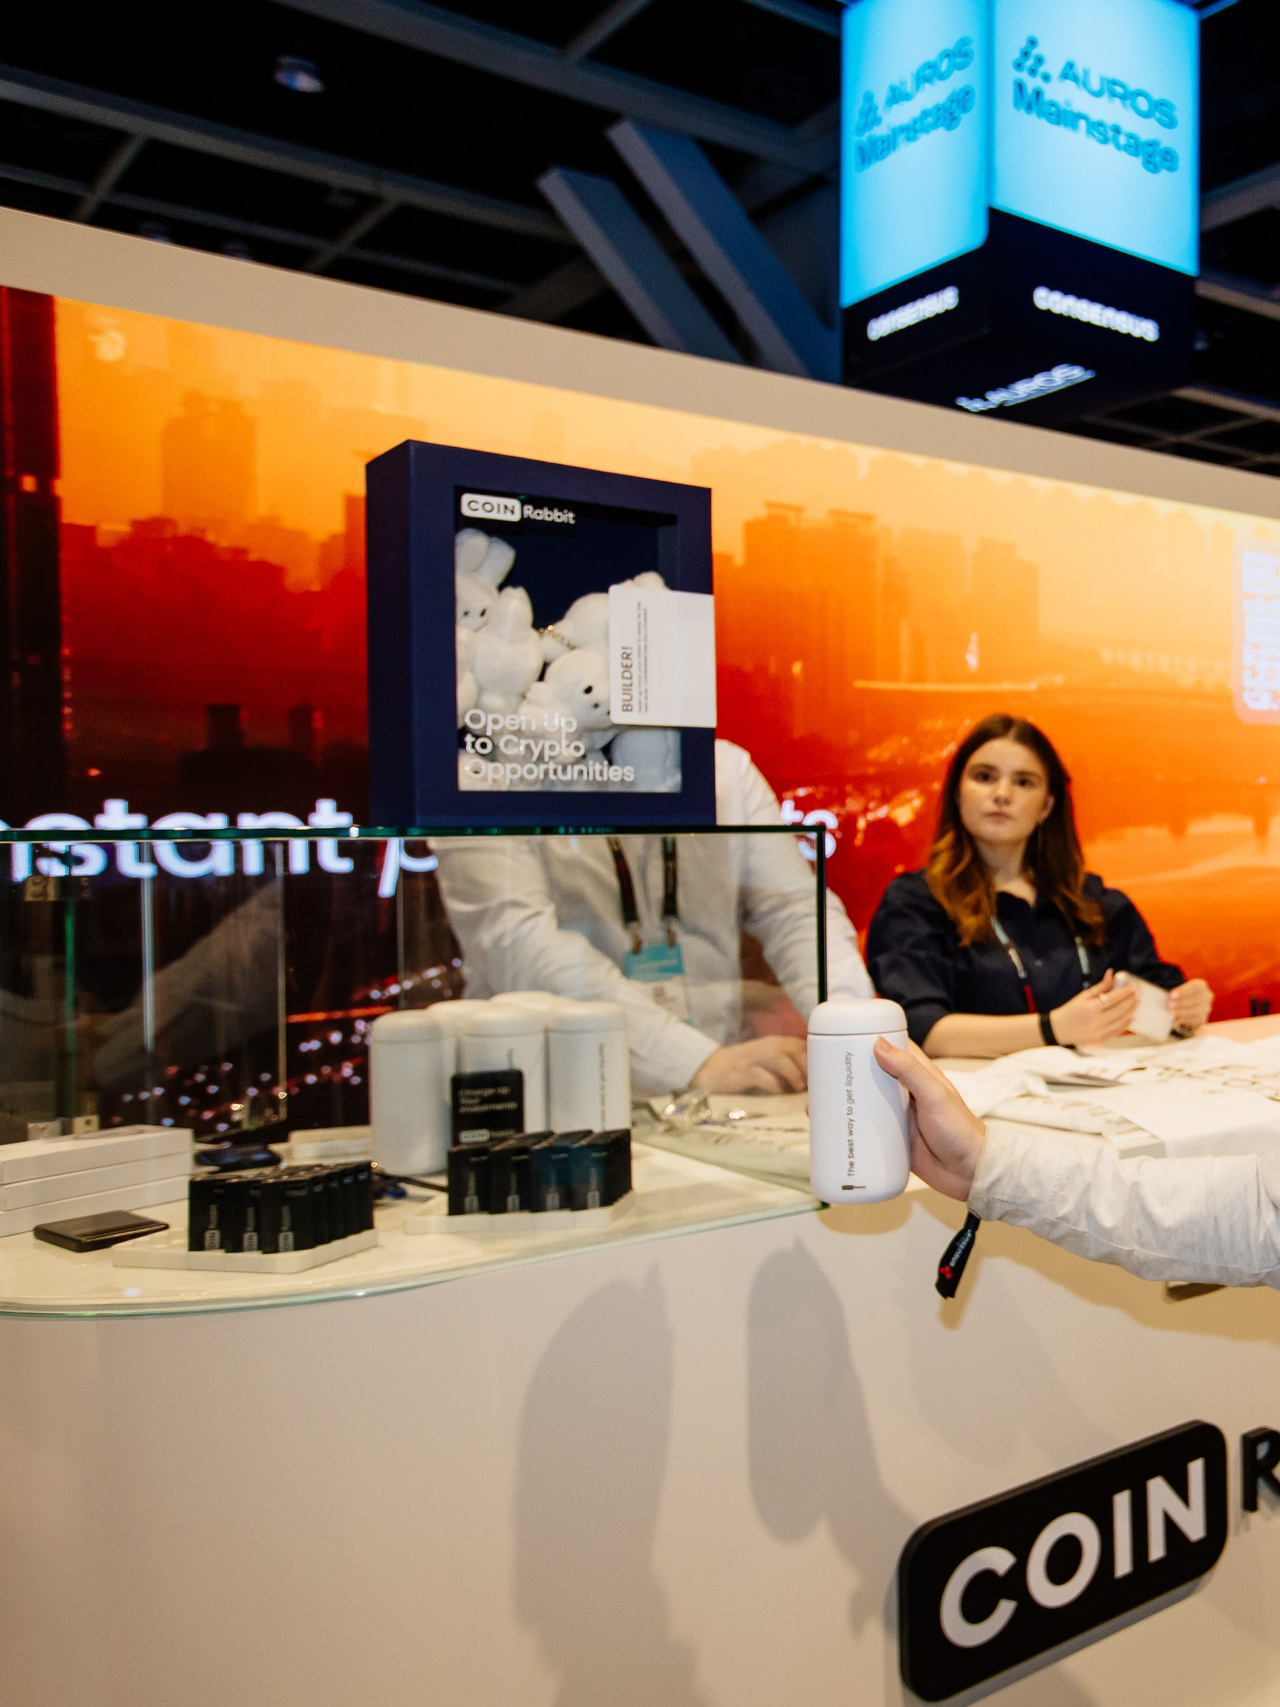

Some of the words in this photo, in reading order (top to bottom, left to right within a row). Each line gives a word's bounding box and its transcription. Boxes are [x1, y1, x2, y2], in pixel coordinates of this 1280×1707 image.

[884, 36, 974, 108] AUROS
[1059, 60, 1178, 130] AUROS
[1012, 78, 1179, 174] Mainstage
[467, 500, 517, 518] COIN
[523, 504, 576, 525] Rabbit
[621, 646, 633, 712] BUILDER!
[464, 708, 537, 736] Open
[543, 712, 577, 738] Up
[464, 734, 494, 755] to
[499, 735, 586, 762] Crypto
[464, 759, 635, 785] Opportunities
[844, 1051, 854, 1086] liquidity
[846, 1089, 855, 1105] get
[846, 1106, 853, 1116] to
[847, 1118, 855, 1136] way
[940, 1457, 1207, 1648] COIN
